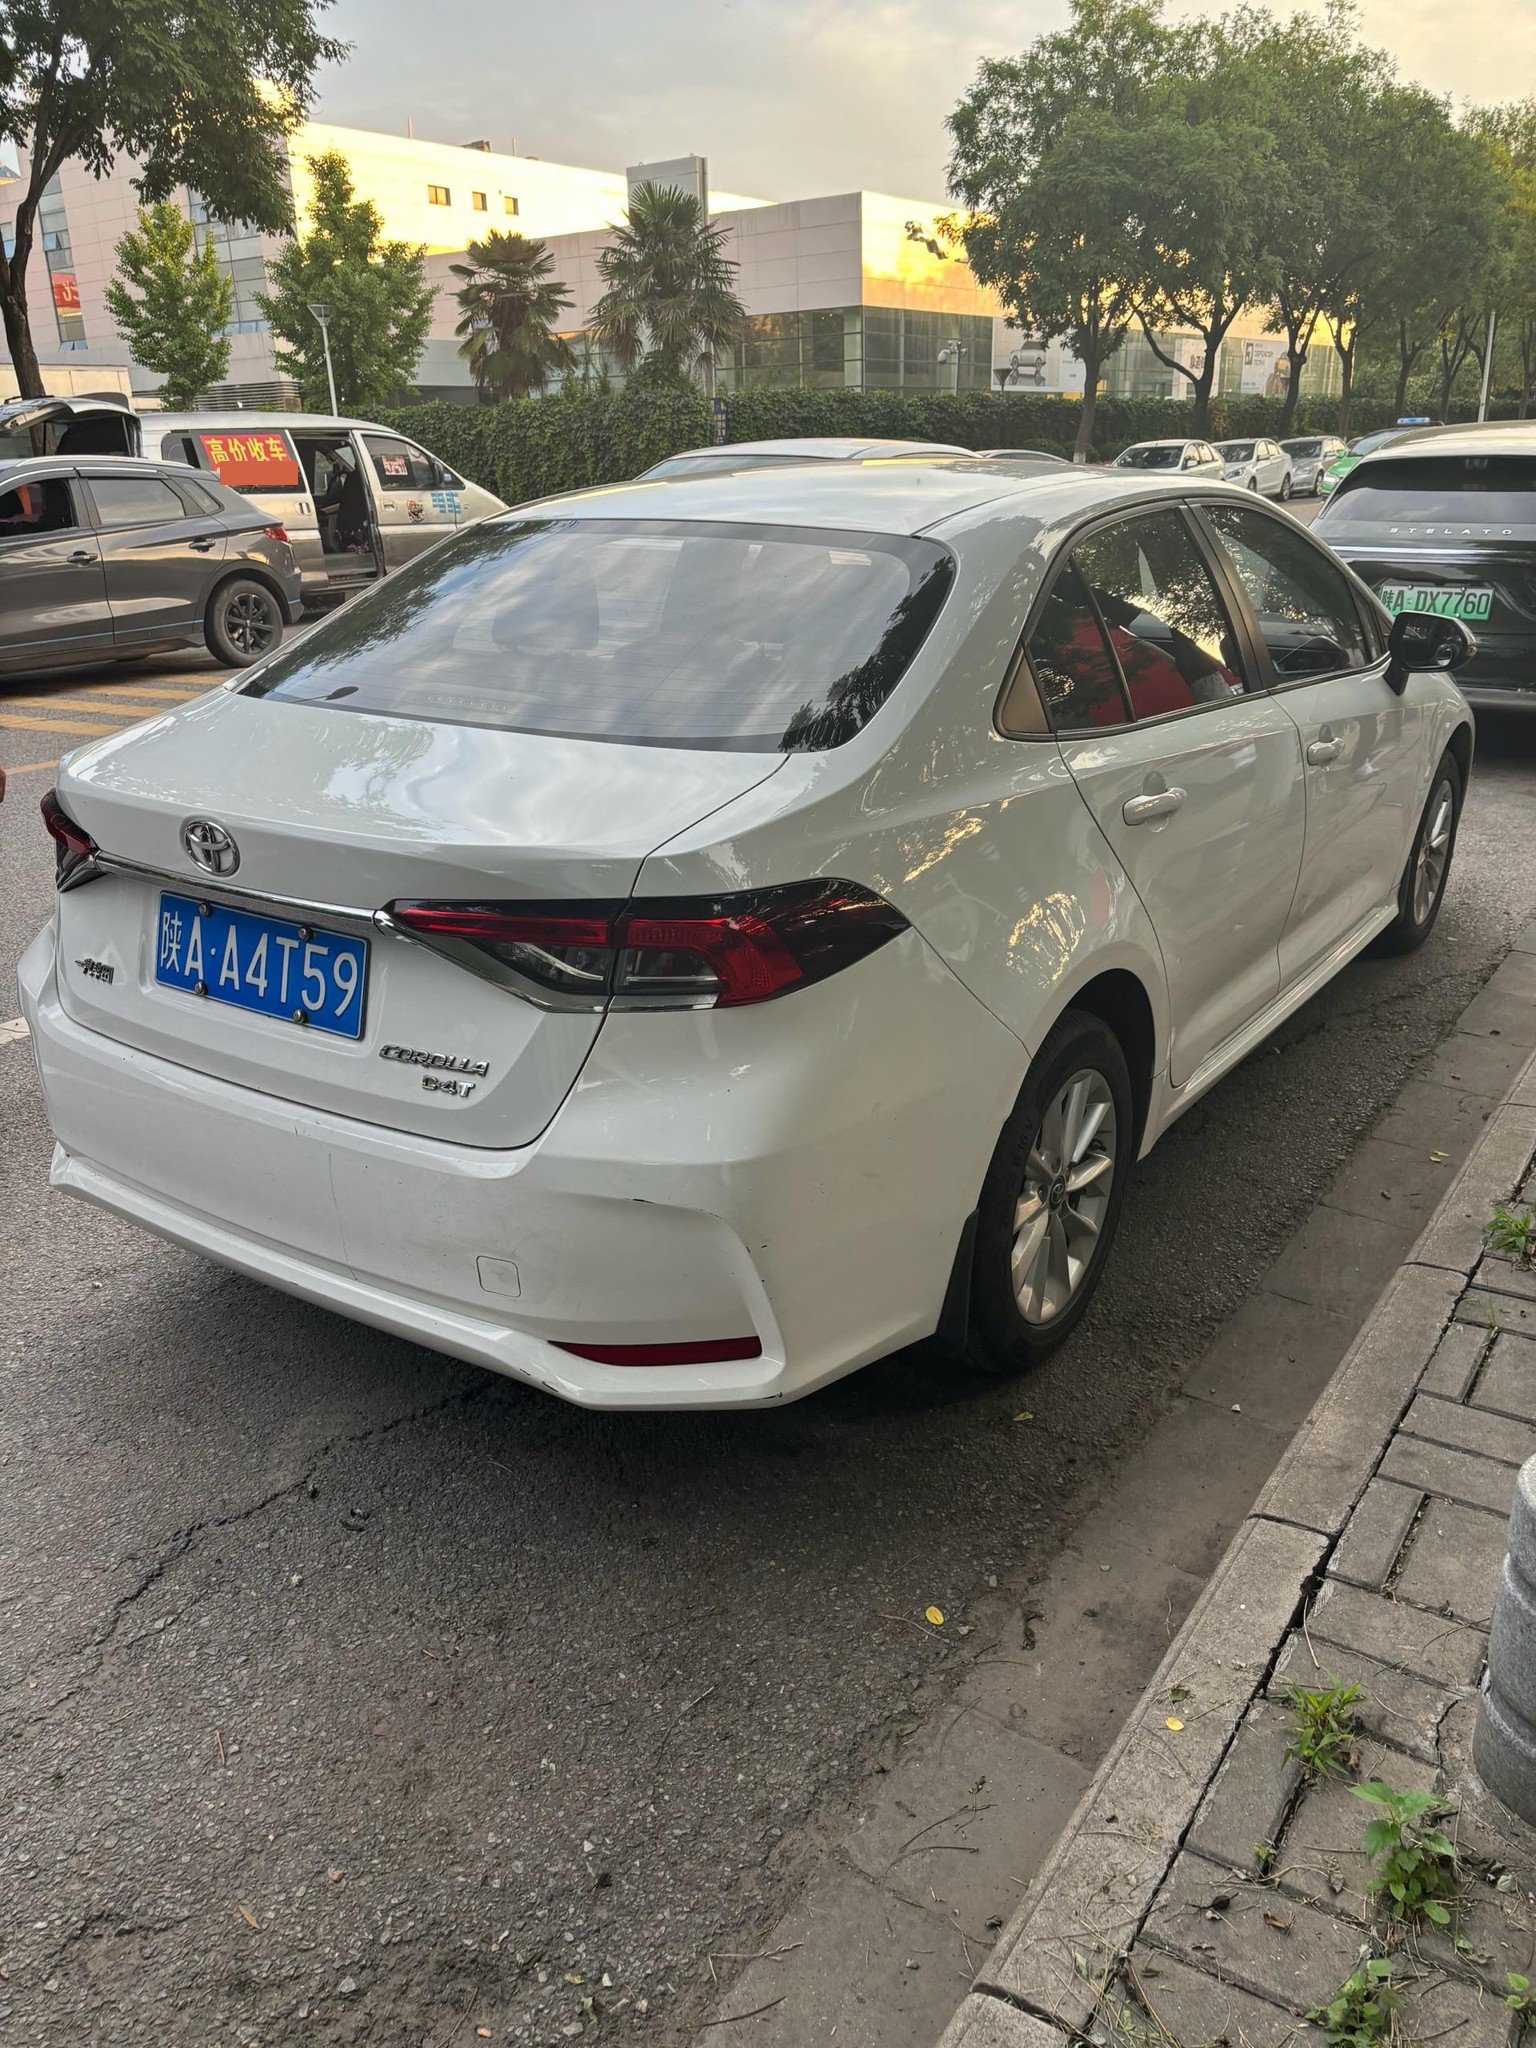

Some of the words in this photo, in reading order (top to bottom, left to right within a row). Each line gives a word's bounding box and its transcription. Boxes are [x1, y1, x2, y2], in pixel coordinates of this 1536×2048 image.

[204, 437, 287, 464] 高价收车
[1389, 527, 1513, 536] STELATO
[379, 1044, 489, 1077] COROLLA
